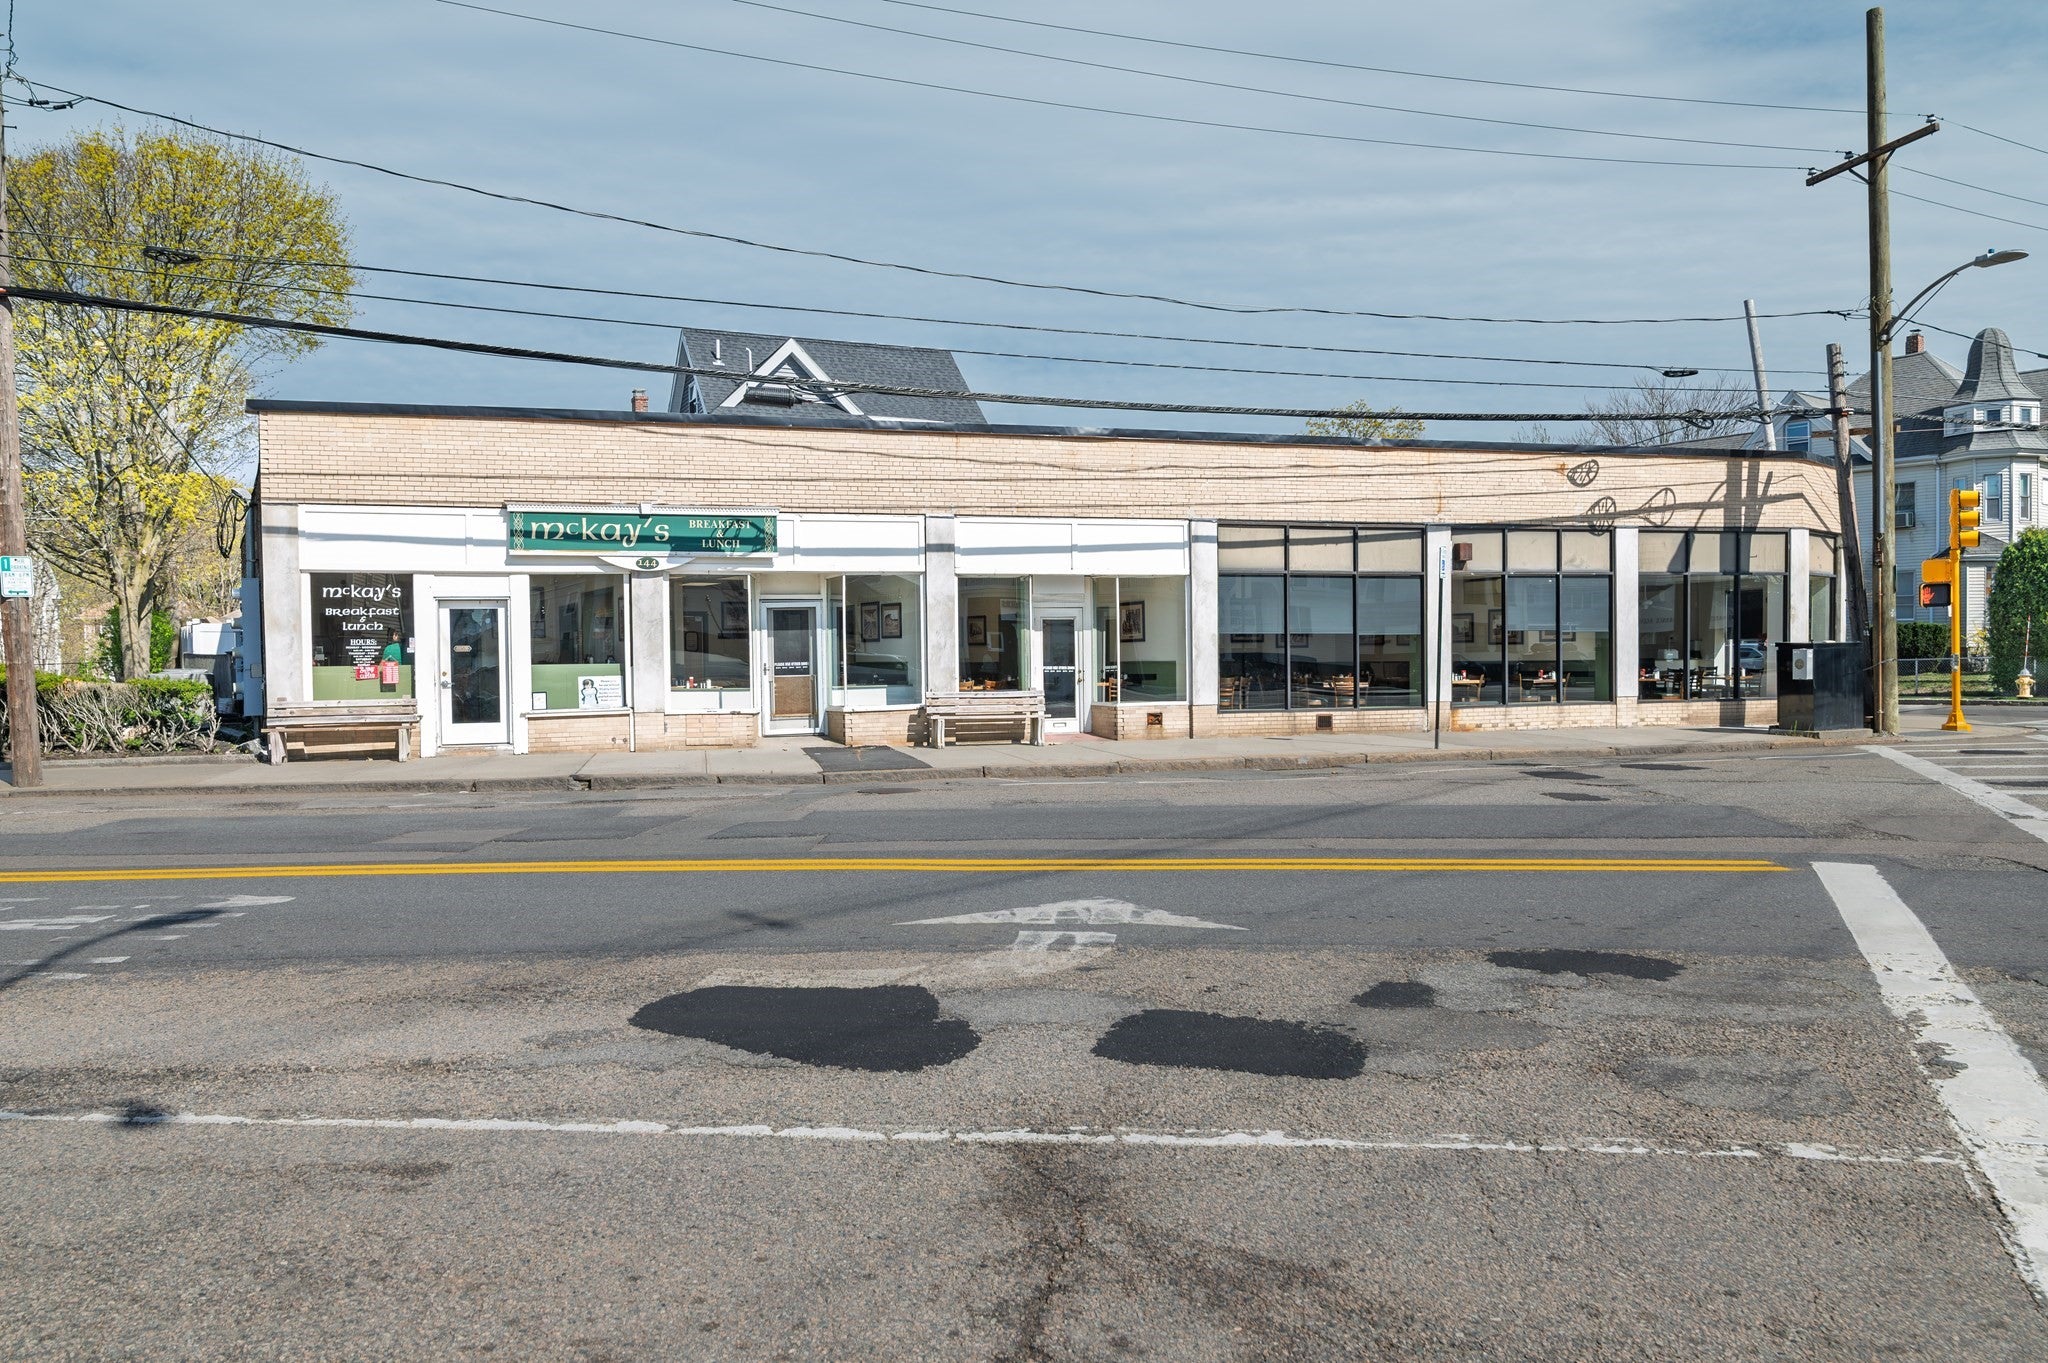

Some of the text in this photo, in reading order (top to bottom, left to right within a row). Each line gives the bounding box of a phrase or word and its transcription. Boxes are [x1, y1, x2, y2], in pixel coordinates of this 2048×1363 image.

[688, 519, 752, 530] BREAKFAST
[716, 530, 725, 538] &
[702, 538, 741, 549] LUNCH
[637, 559, 658, 568] 144
[350, 638, 378, 646] HOURS:
